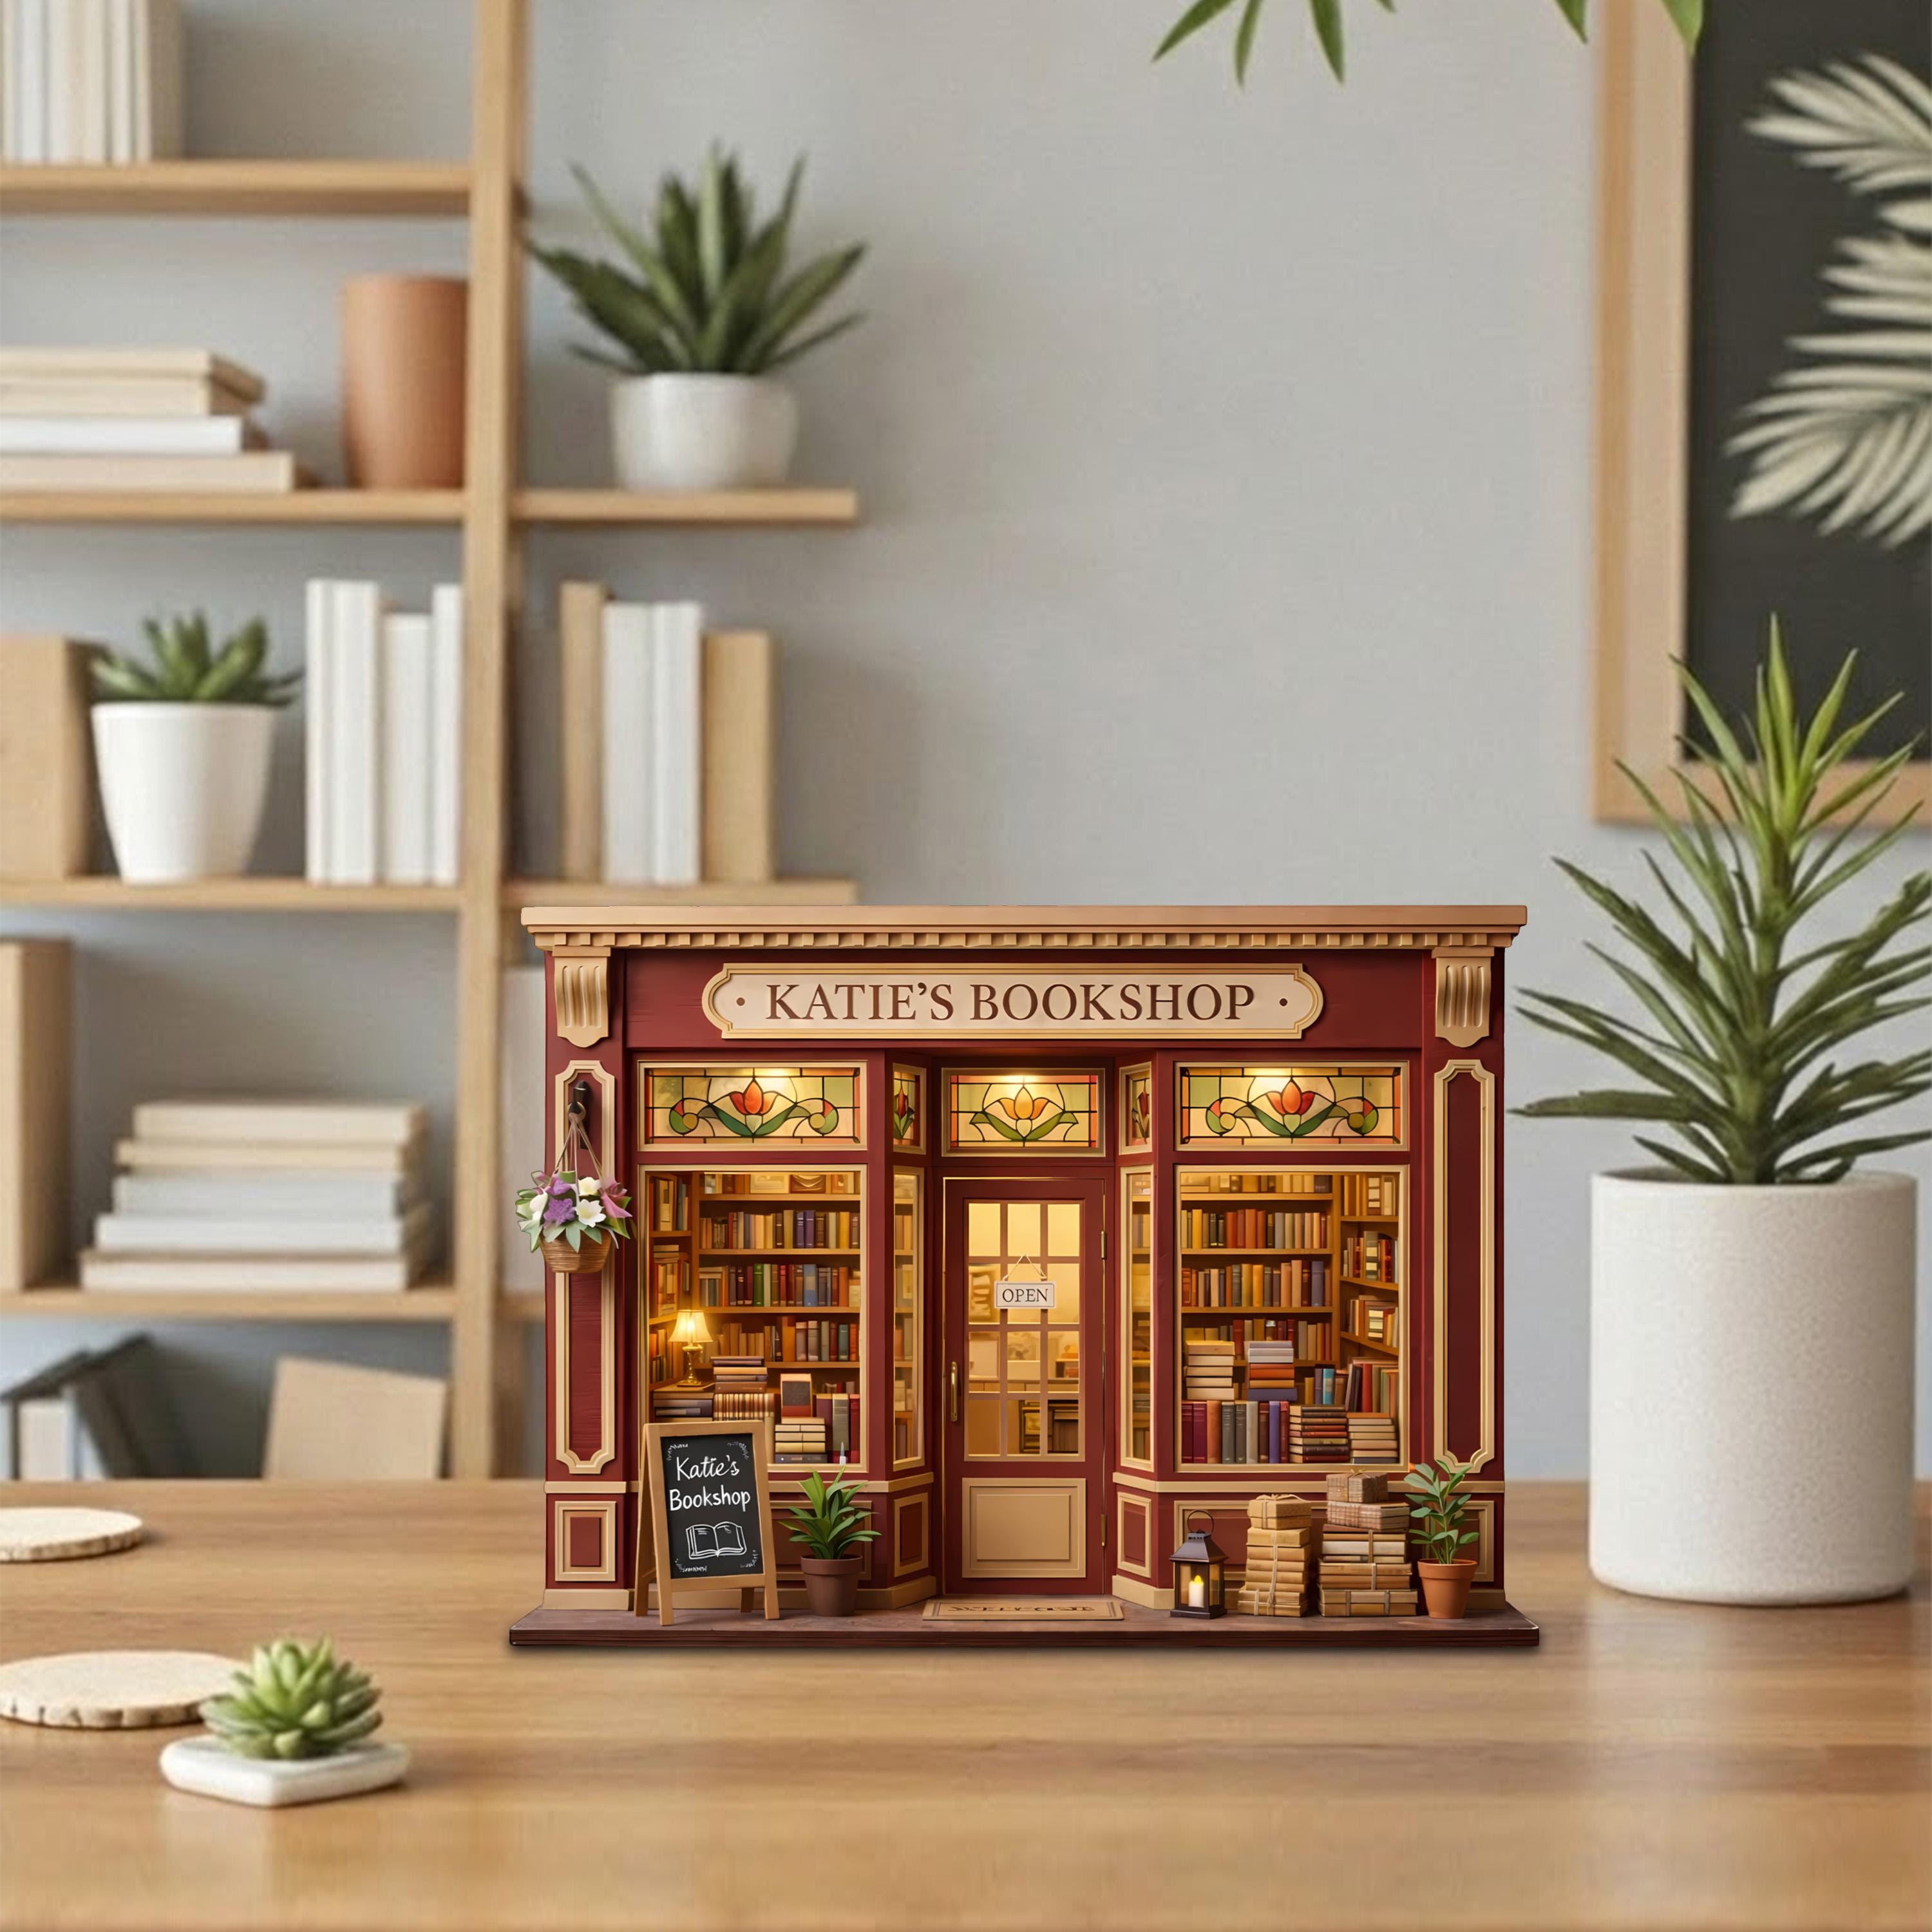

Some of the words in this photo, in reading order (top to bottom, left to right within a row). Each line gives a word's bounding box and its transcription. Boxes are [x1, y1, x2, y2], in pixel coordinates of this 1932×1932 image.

[766, 982, 954, 1021] KATIE’S
[969, 983, 1255, 1021] BOOKSHOP
[1002, 1289, 1048, 1302] OPEN
[676, 1455, 740, 1481] Katie's
[669, 1484, 751, 1512] Bookshop
